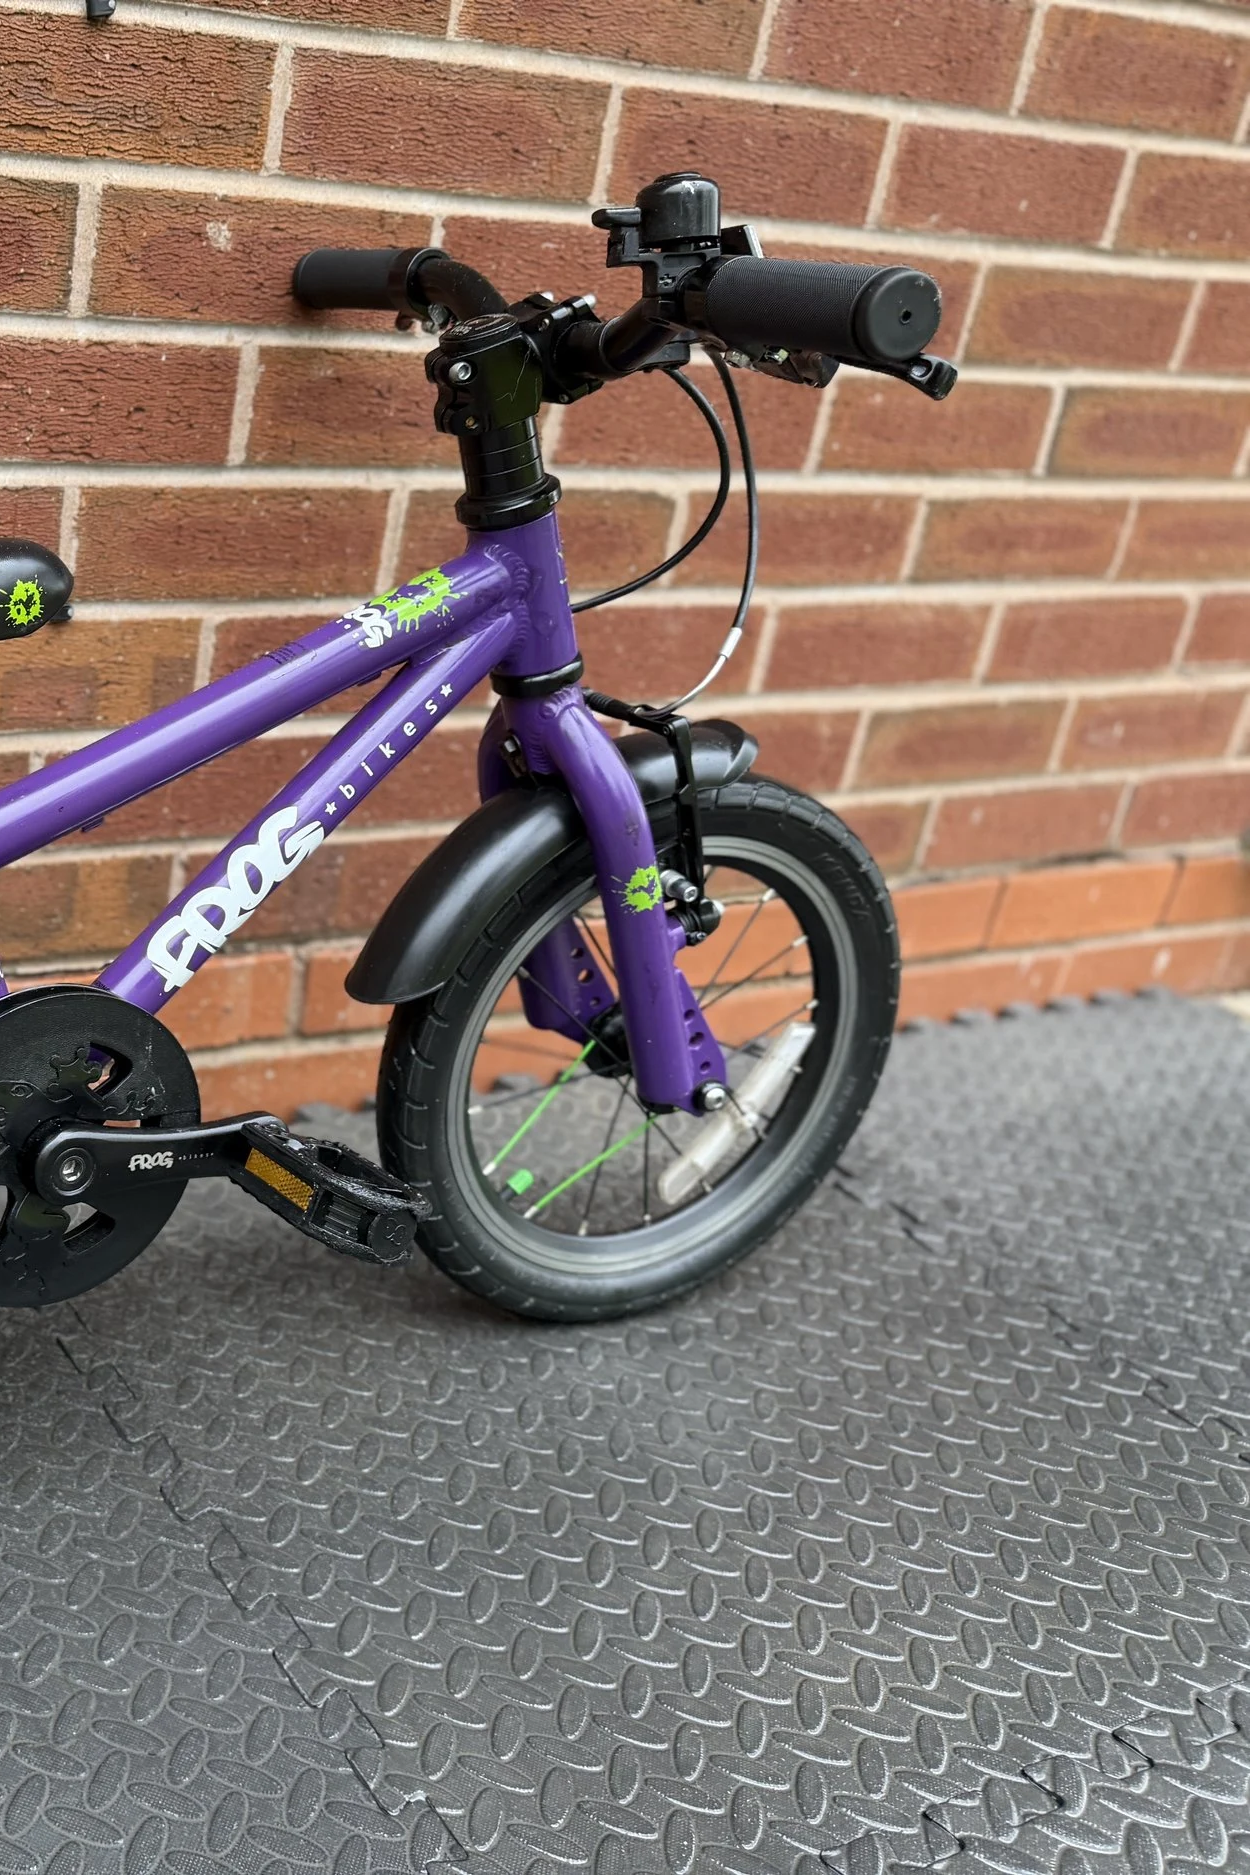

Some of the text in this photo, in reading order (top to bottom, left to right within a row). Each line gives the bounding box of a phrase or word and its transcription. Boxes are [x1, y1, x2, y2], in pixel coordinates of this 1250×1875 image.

[146, 699, 439, 993] FROG bikes
[128, 1151, 174, 1172] FROG
